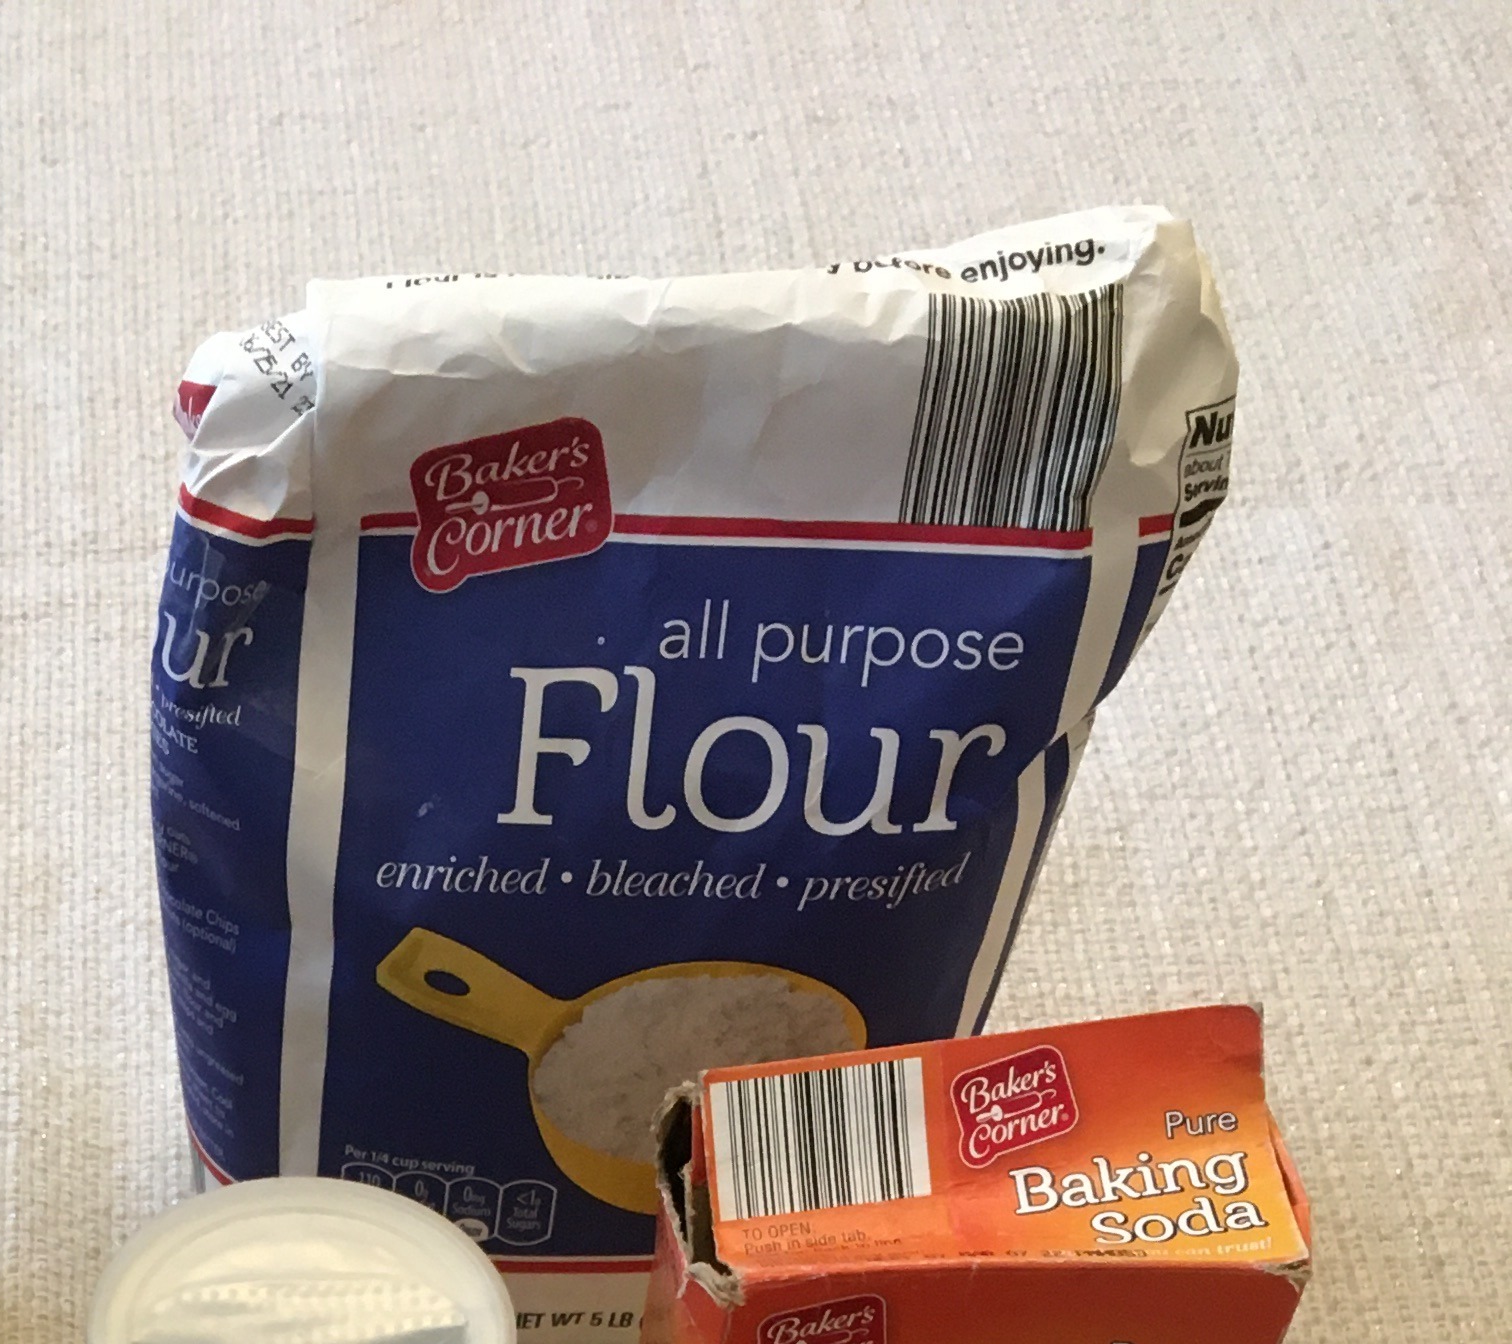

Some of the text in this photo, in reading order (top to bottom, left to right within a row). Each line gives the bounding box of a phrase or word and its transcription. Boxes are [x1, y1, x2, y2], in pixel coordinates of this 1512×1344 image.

[960, 238, 1106, 283] enjoying.
[424, 436, 591, 502] Baker's
[1184, 457, 1223, 479] about
[426, 502, 593, 576] Corner
[169, 561, 268, 611] urpose
[658, 599, 1025, 688] all purpose
[496, 665, 1007, 837] Flour
[375, 852, 973, 911] enriched bleached presifted
[206, 908, 240, 936] Chips
[960, 1058, 1058, 1116] Baker's
[968, 1102, 1066, 1161] Corner
[1164, 1110, 1240, 1140] Pure
[345, 1144, 367, 1161] Per
[392, 1156, 420, 1171] cup
[422, 1160, 475, 1178] serving
[1008, 1151, 1251, 1218] Baking
[513, 1206, 538, 1220] Total
[741, 1228, 763, 1241] TO
[1090, 1196, 1269, 1246] Soda
[743, 1240, 784, 1256] Push
[805, 1235, 837, 1249] side
[1217, 1236, 1273, 1255] trust!
[551, 1311, 586, 1328] WT
[589, 1310, 605, 1328] 5
[608, 1311, 635, 1329] LB
